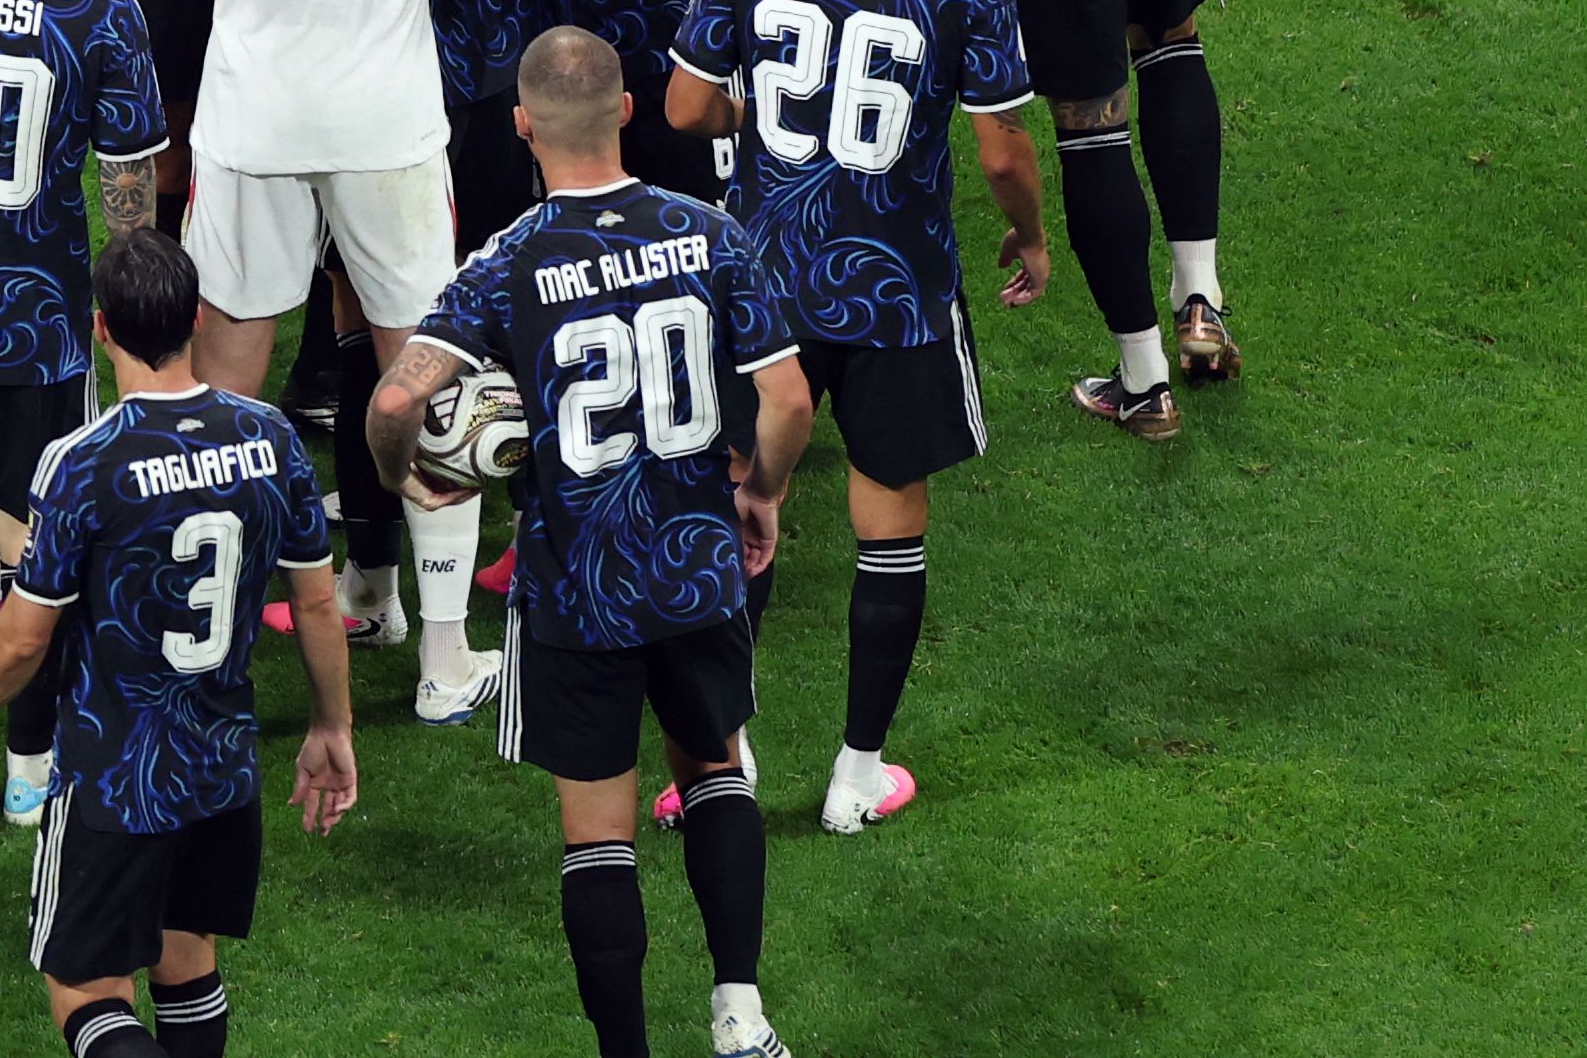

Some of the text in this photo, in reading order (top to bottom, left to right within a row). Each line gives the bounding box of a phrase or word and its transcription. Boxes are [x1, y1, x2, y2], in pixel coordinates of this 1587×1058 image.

[534, 232, 710, 305] MAC ALLISTER
[552, 295, 722, 478] 20
[128, 437, 279, 498] TAGLIAFICO
[161, 509, 245, 675] 3
[421, 558, 457, 574] ENG
